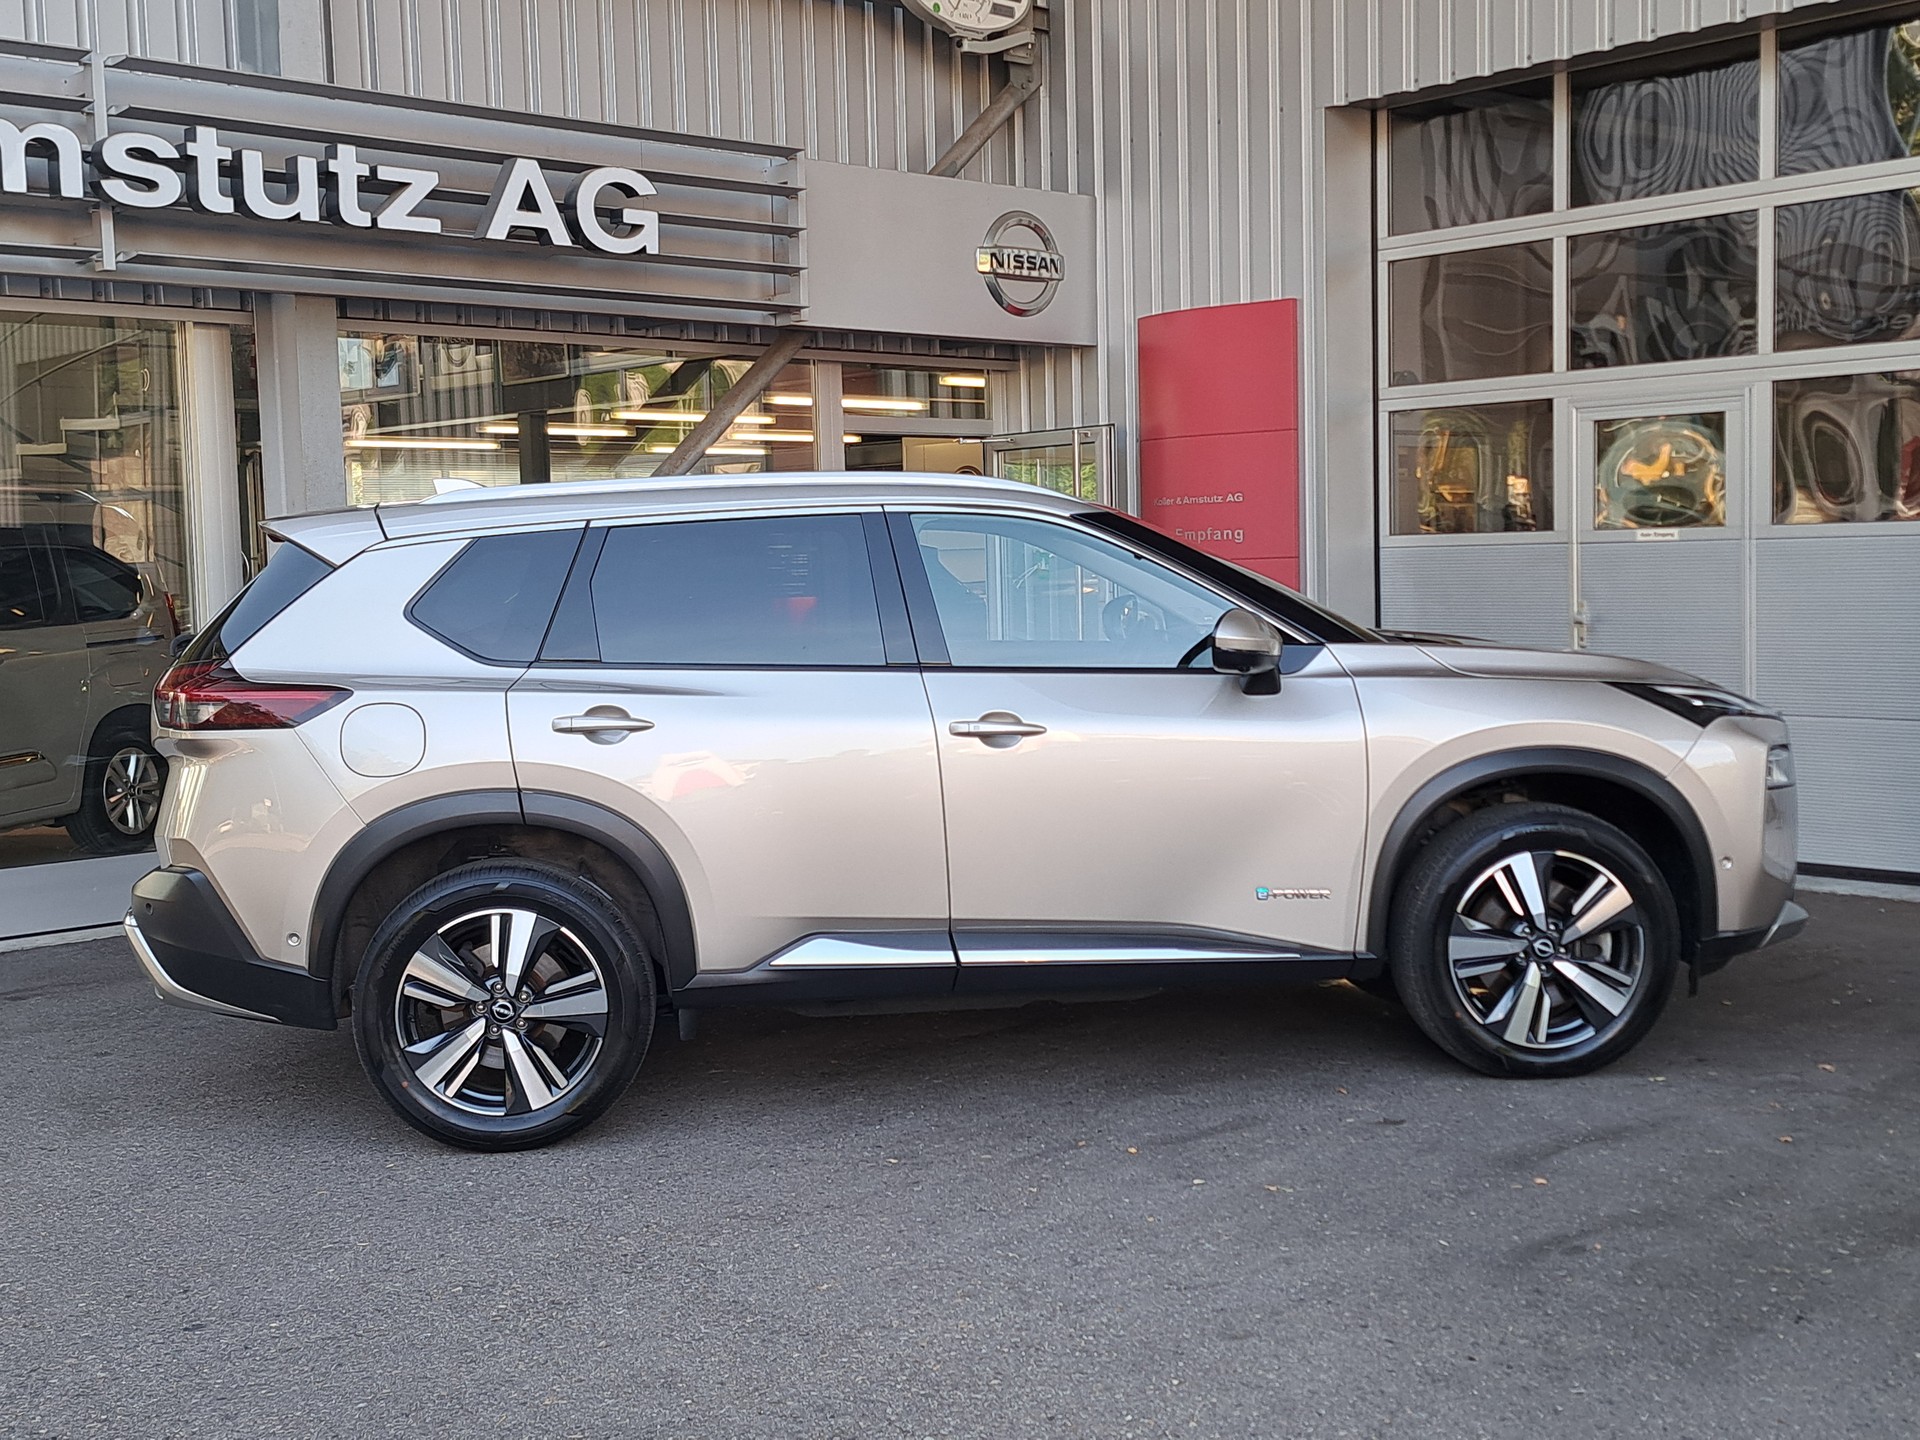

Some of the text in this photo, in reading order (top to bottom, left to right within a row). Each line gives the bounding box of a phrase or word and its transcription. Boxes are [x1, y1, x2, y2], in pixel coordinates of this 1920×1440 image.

[484, 157, 660, 255] AG
[990, 252, 1059, 274] NISSAN
[1175, 496, 1182, 505] &
[1182, 494, 1224, 505] Amstutz
[1225, 492, 1244, 503] AG
